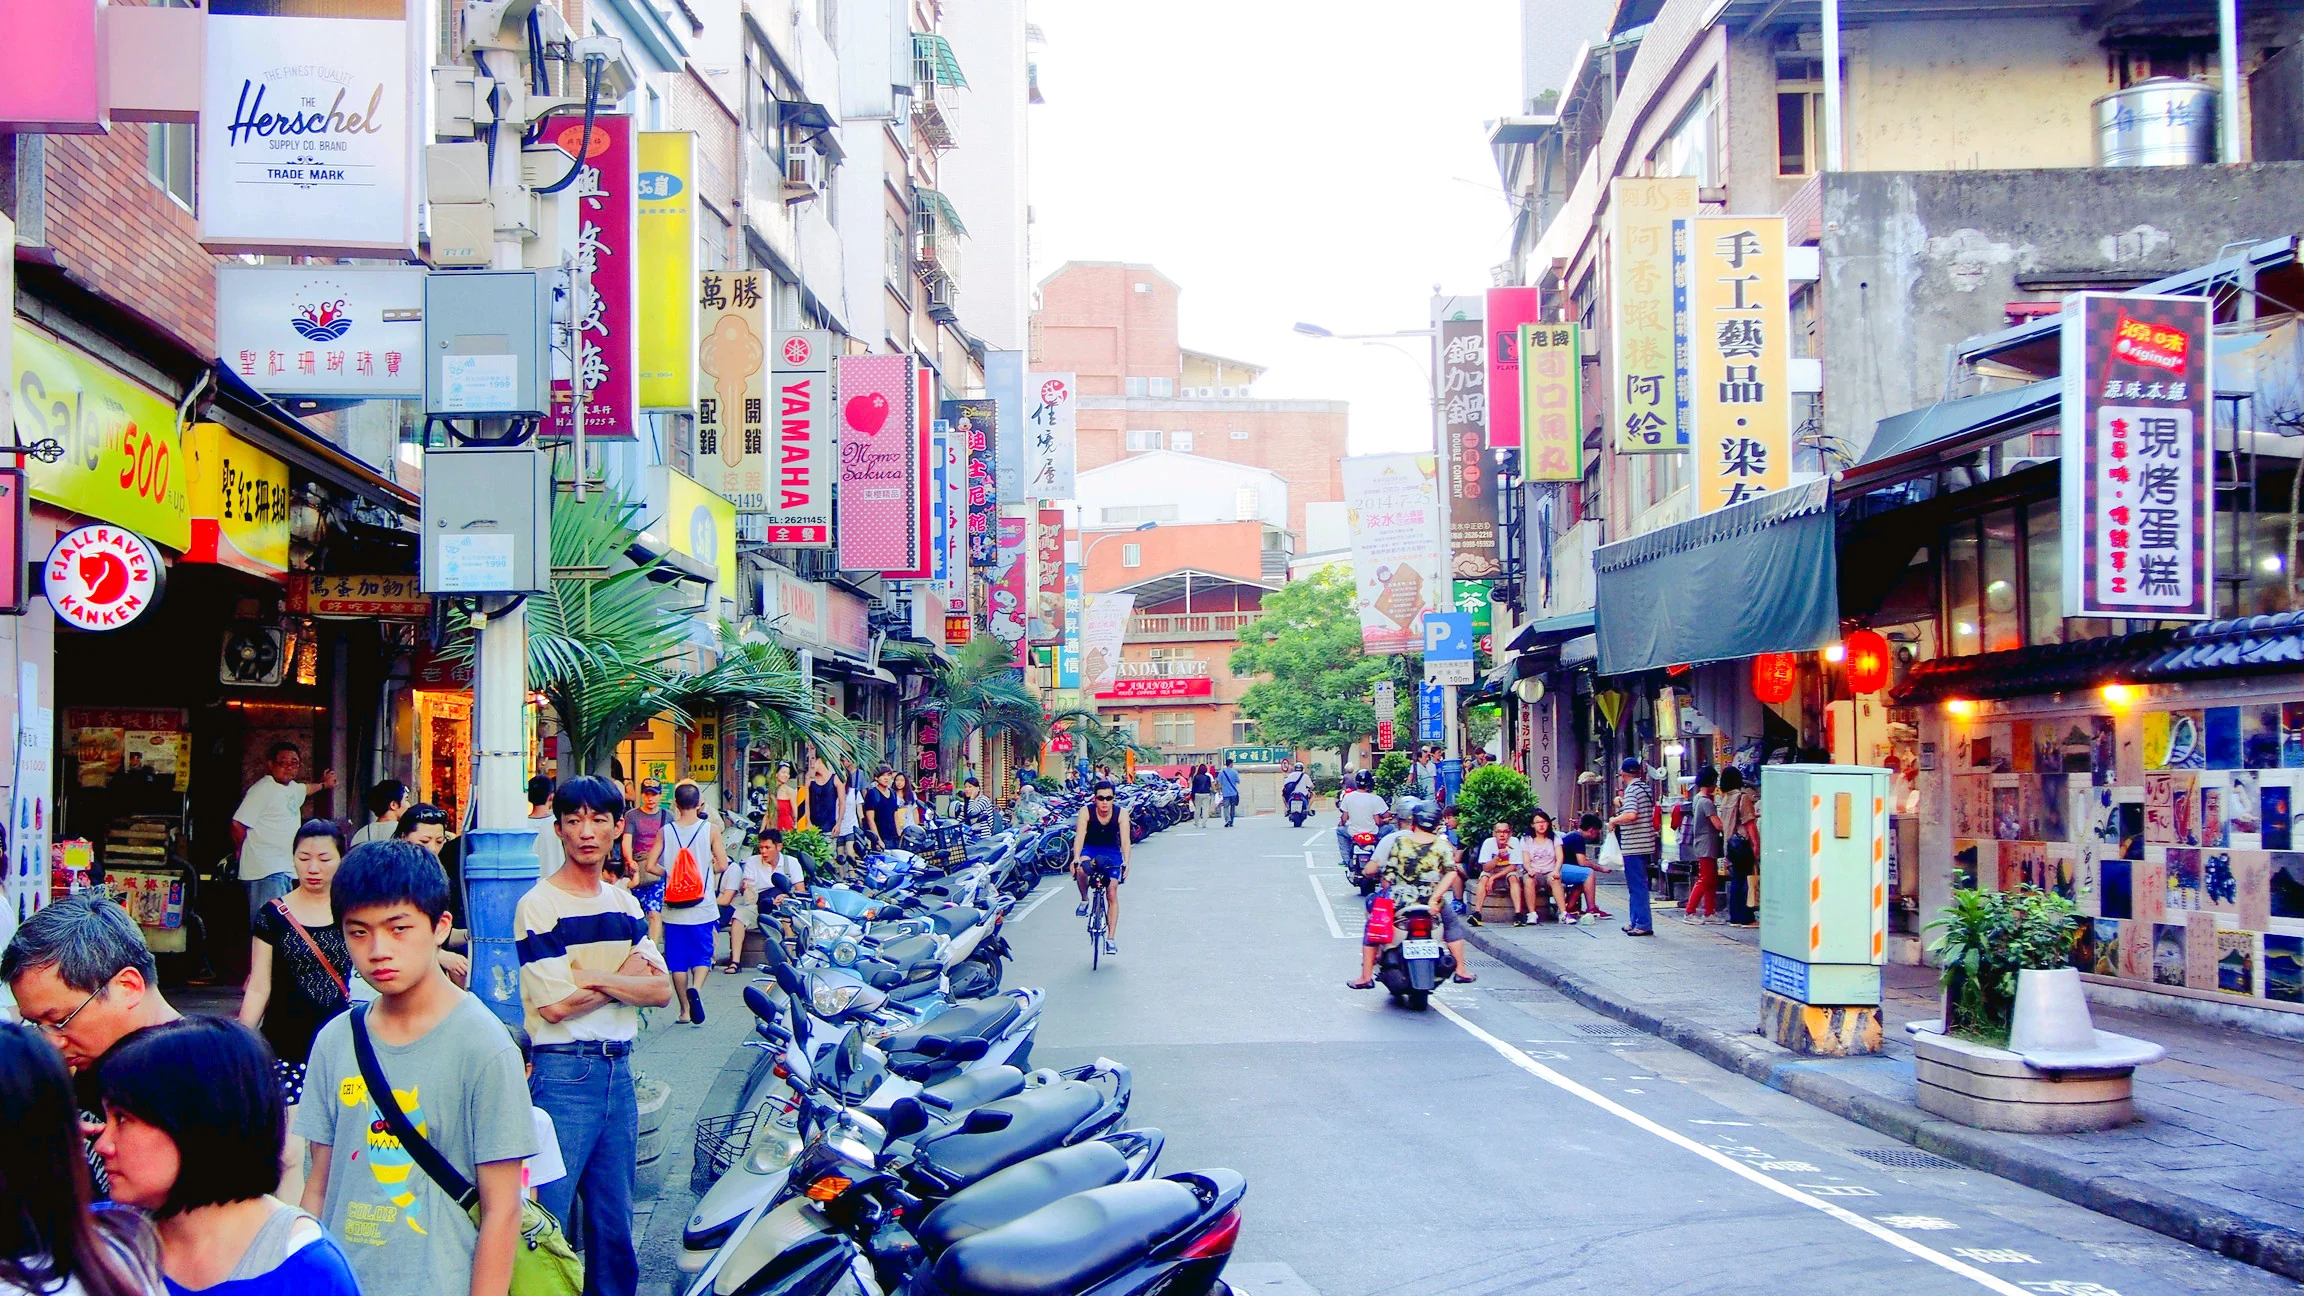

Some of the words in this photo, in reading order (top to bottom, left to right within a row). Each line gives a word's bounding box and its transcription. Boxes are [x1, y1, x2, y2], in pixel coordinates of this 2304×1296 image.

[264, 70, 281, 83] THE
[283, 65, 315, 79] FINEST
[317, 65, 354, 83] QUALITY
[228, 79, 384, 147] Herschel
[301, 97, 316, 108] THE
[269, 140, 301, 151] SUPPLY
[303, 140, 317, 151] CO.
[319, 141, 347, 152] BRAND
[267, 168, 304, 181] TRADE
[309, 169, 345, 181] MARK
[700, 276, 763, 310] 萬勝
[1531, 331, 1569, 347] 老牌
[240, 349, 402, 378] 聖紅珊瑚珠寶
[1444, 335, 1486, 426] 鍋加鍋
[20, 370, 99, 473] Sale
[1536, 351, 1570, 473] 可口魚丸
[1625, 374, 1668, 445] 阿給
[700, 398, 717, 456] 配鎖
[745, 398, 762, 456] 開鎖
[781, 379, 810, 509] YAMAHA
[842, 442, 900, 463] Momo
[1452, 433, 1461, 462] DOUBLE
[120, 421, 170, 504] 500
[842, 462, 903, 481] Sakura
[222, 458, 289, 531] 聖紅珊瑚
[1452, 463, 1462, 498] CONTENT
[768, 516, 827, 524] EL:26211453
[1366, 512, 1395, 528] 淡水
[2138, 417, 2181, 597] 現烤蛋糕
[775, 527, 816, 541] 全發
[52, 529, 148, 582] FJALLRAVEN
[60, 594, 142, 626] KANKEN
[790, 583, 816, 625] YAMAHA
[1426, 621, 1452, 651] P
[1117, 661, 1160, 677] ANDA
[1541, 716, 1549, 750] PLAY
[1541, 756, 1549, 782] BOY
[347, 1201, 398, 1223] COLOR
[345, 1220, 381, 1237] SOUL
